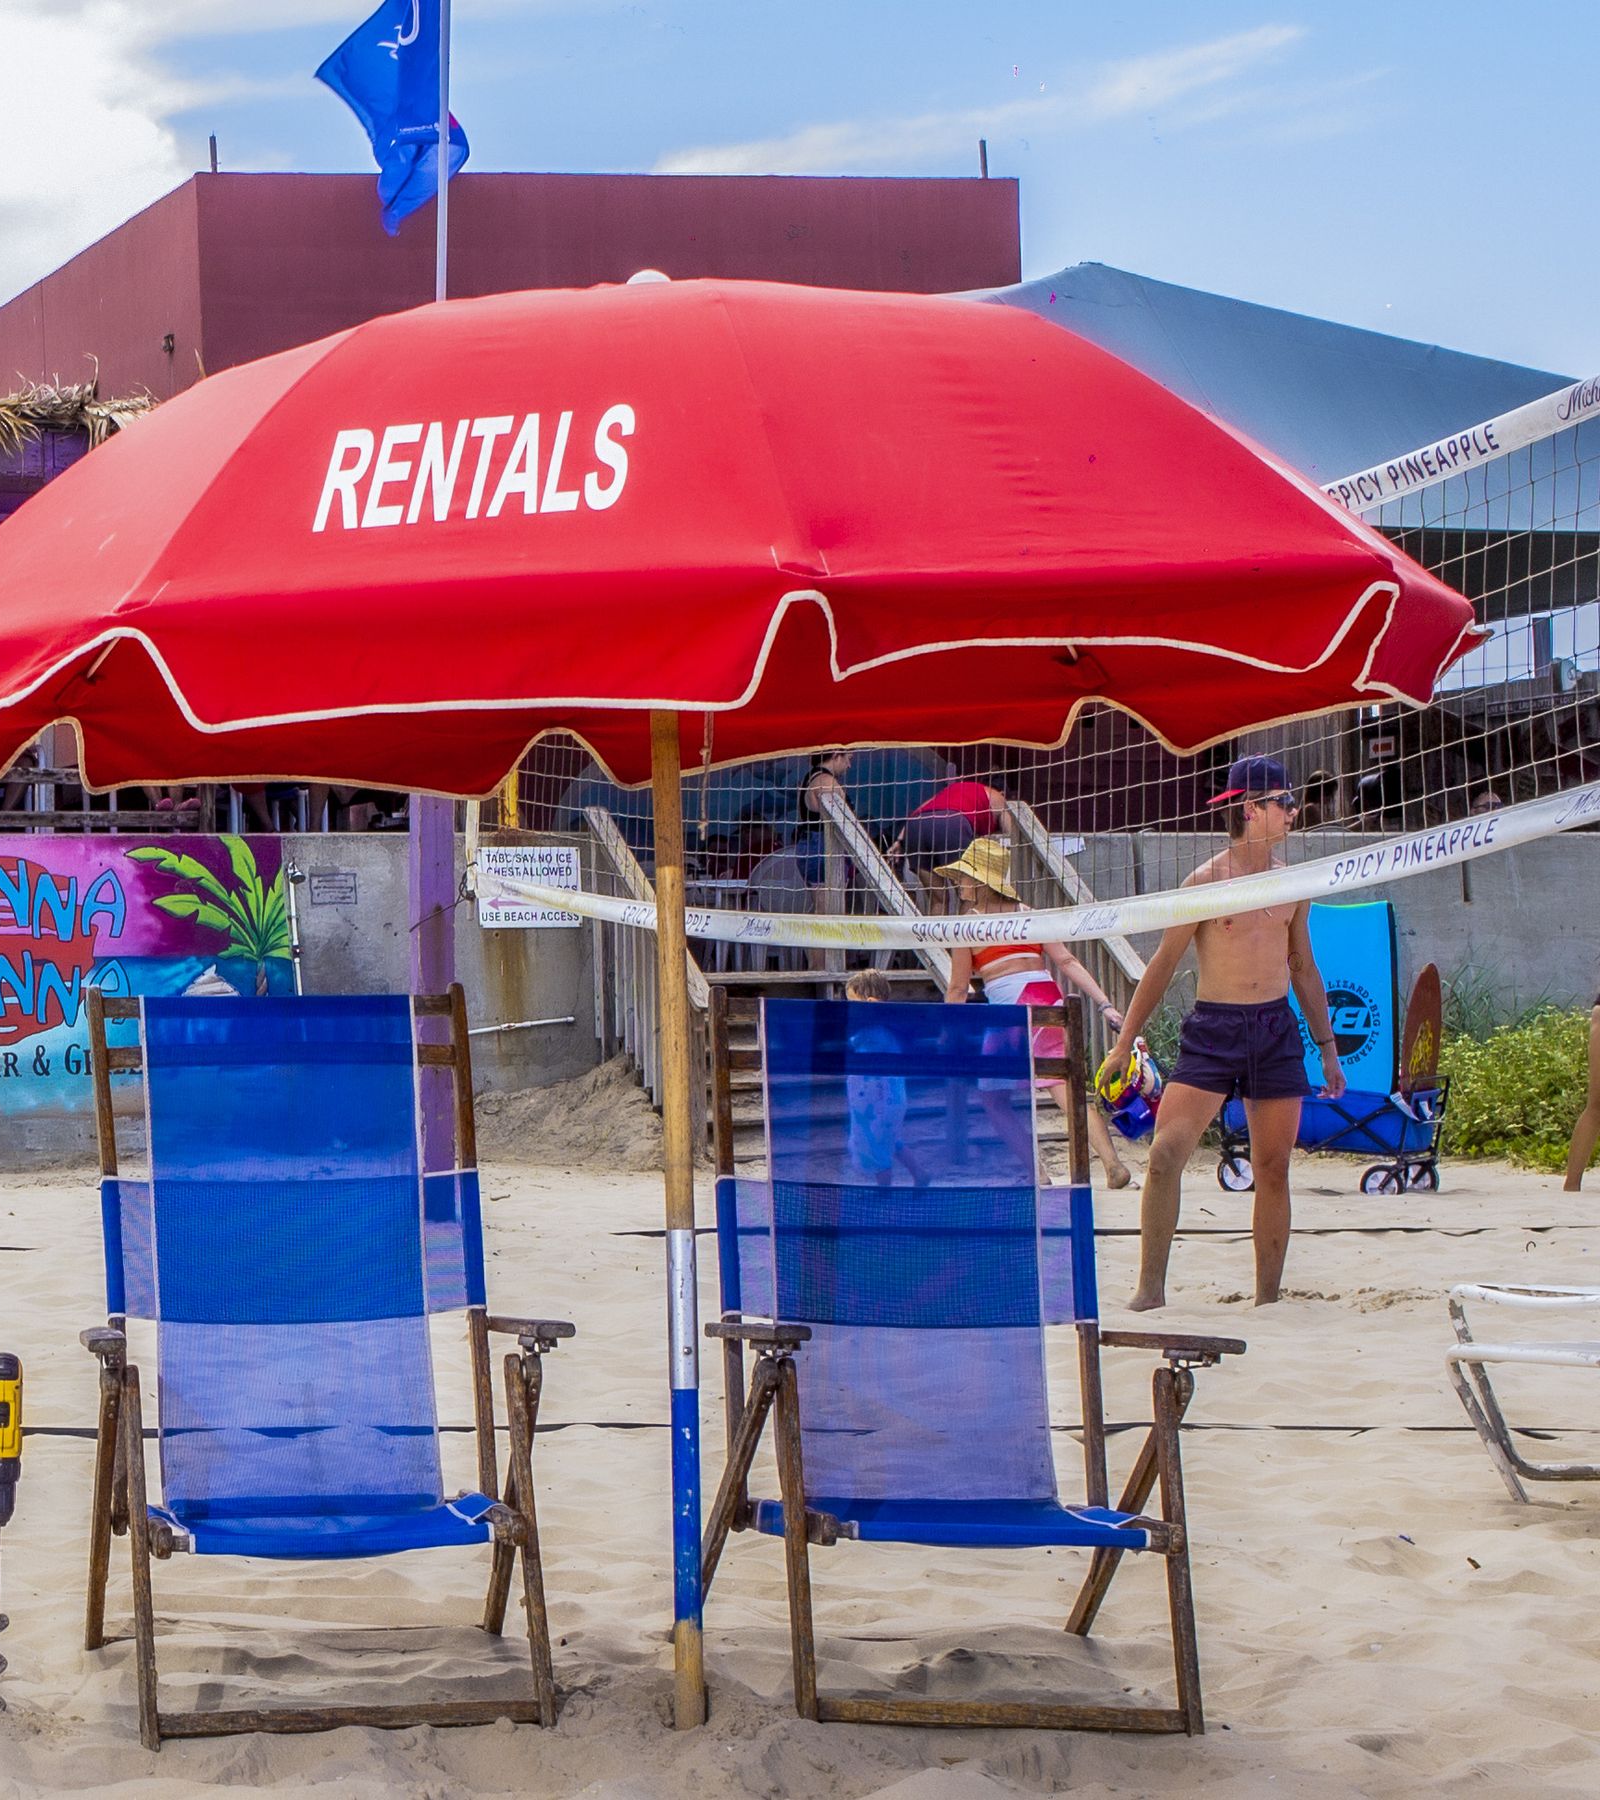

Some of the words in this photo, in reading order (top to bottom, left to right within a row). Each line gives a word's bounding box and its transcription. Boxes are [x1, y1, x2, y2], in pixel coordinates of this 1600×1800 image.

[312, 404, 636, 533] RENTALS
[1327, 470, 1384, 510] SPICY
[1387, 423, 1500, 490] PINEAPPLE
[486, 853, 512, 863] TABC
[538, 853, 553, 864] NO
[556, 853, 572, 863] ICE
[1329, 849, 1385, 886] SPICY
[1390, 818, 1499, 871] PINEAPPLE
[522, 866, 572, 877] ALLOWED
[482, 911, 501, 922] USE
[504, 911, 538, 922] BEACH
[540, 911, 580, 922] ACCESS
[621, 905, 654, 927] SPICY
[911, 921, 950, 942] SPICY
[953, 918, 1031, 942] PINEAPPLE
[1327, 979, 1370, 999] LIZARD
[1369, 1004, 1381, 1028] BIG
[1346, 1030, 1380, 1066] LIZARD
[32, 1044, 51, 1077] &
